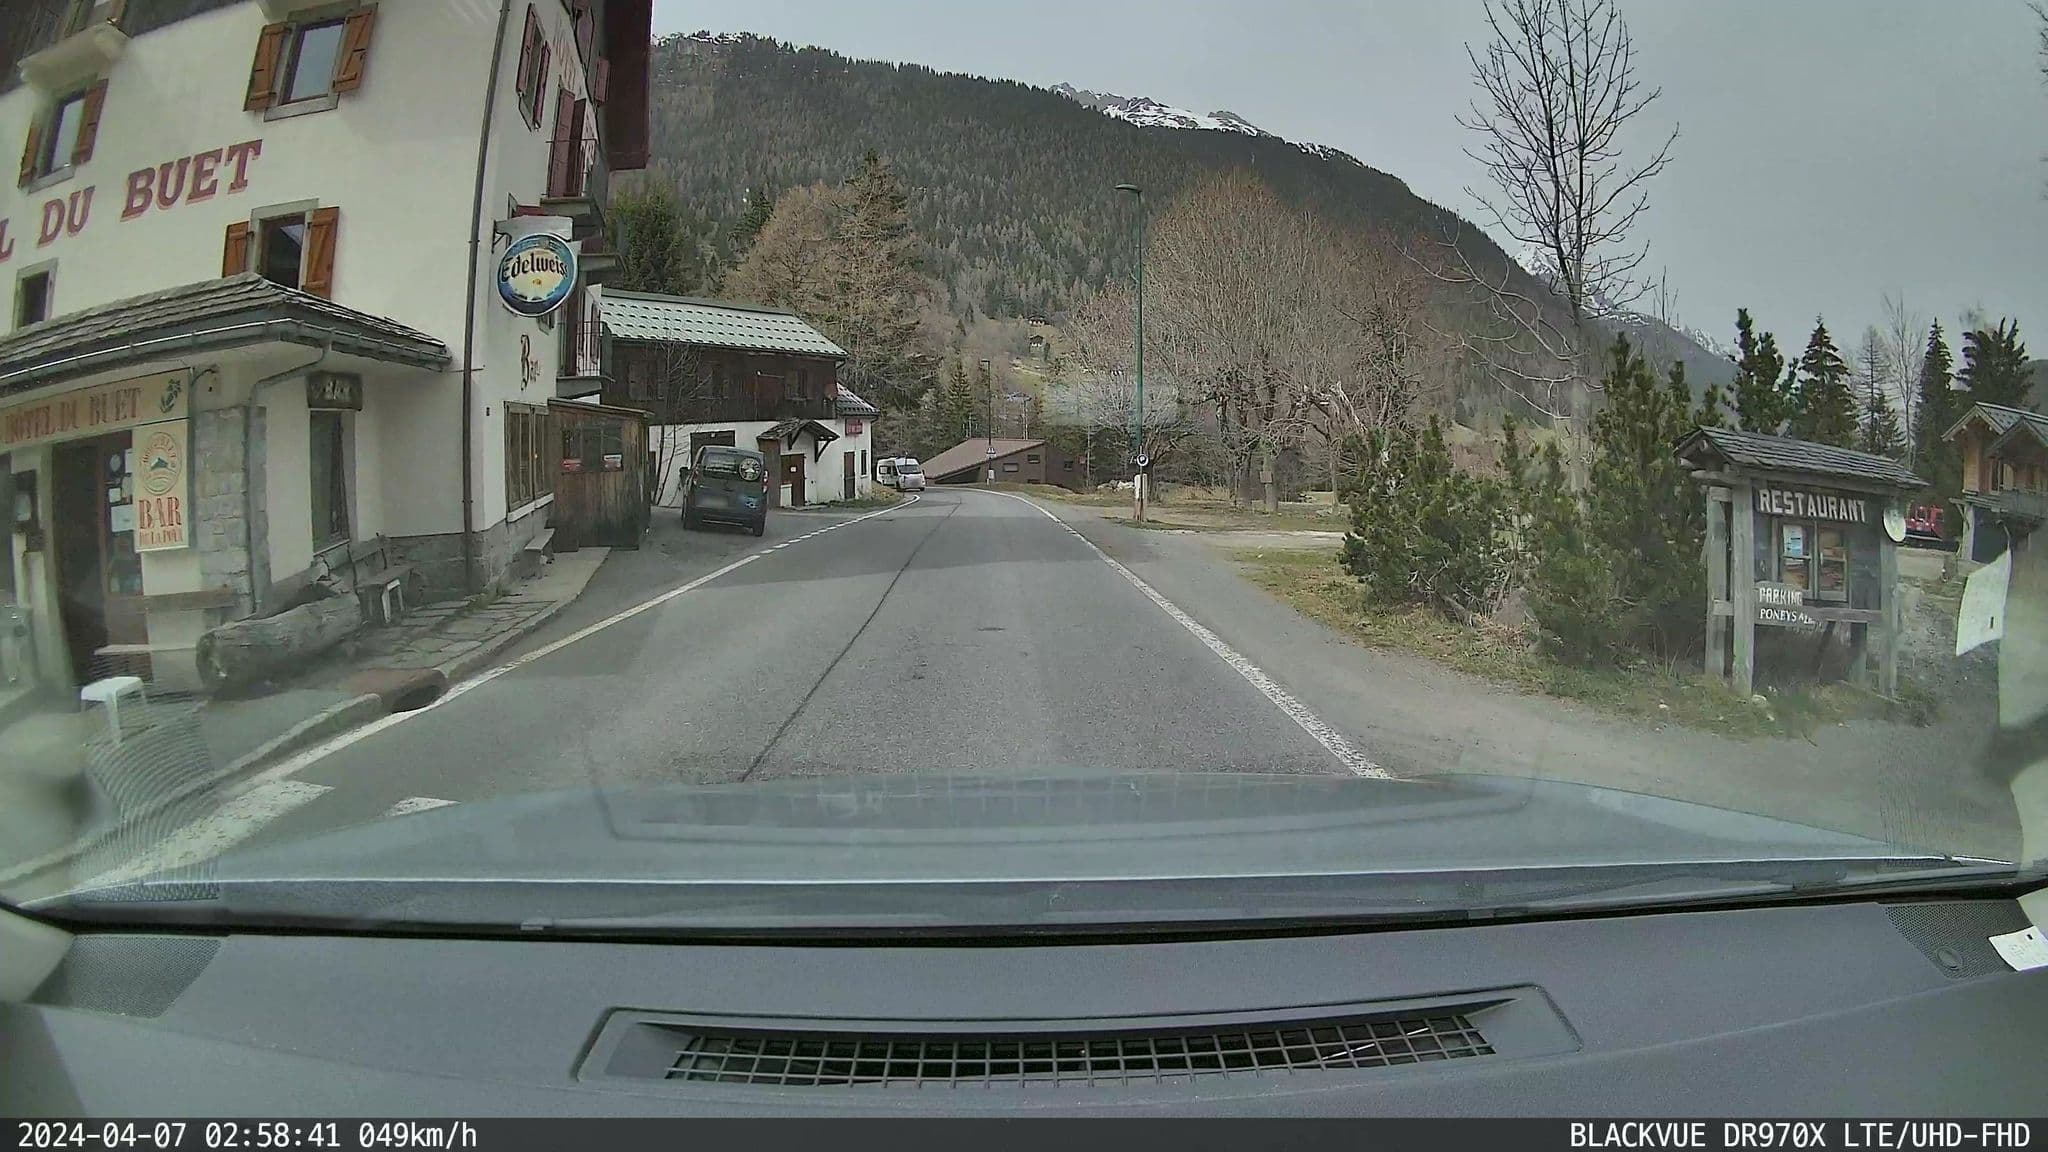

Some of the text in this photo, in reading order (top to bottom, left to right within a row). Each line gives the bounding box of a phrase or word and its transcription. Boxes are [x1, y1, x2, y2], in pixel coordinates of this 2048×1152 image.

[37, 185, 96, 248] DU
[120, 139, 263, 222] BUET
[89, 387, 142, 426] BUET
[139, 497, 182, 529] BAR
[1760, 488, 1866, 522] RESTAURANT
[1760, 587, 1803, 606] PARKING
[1760, 608, 1797, 622] PONEYS
